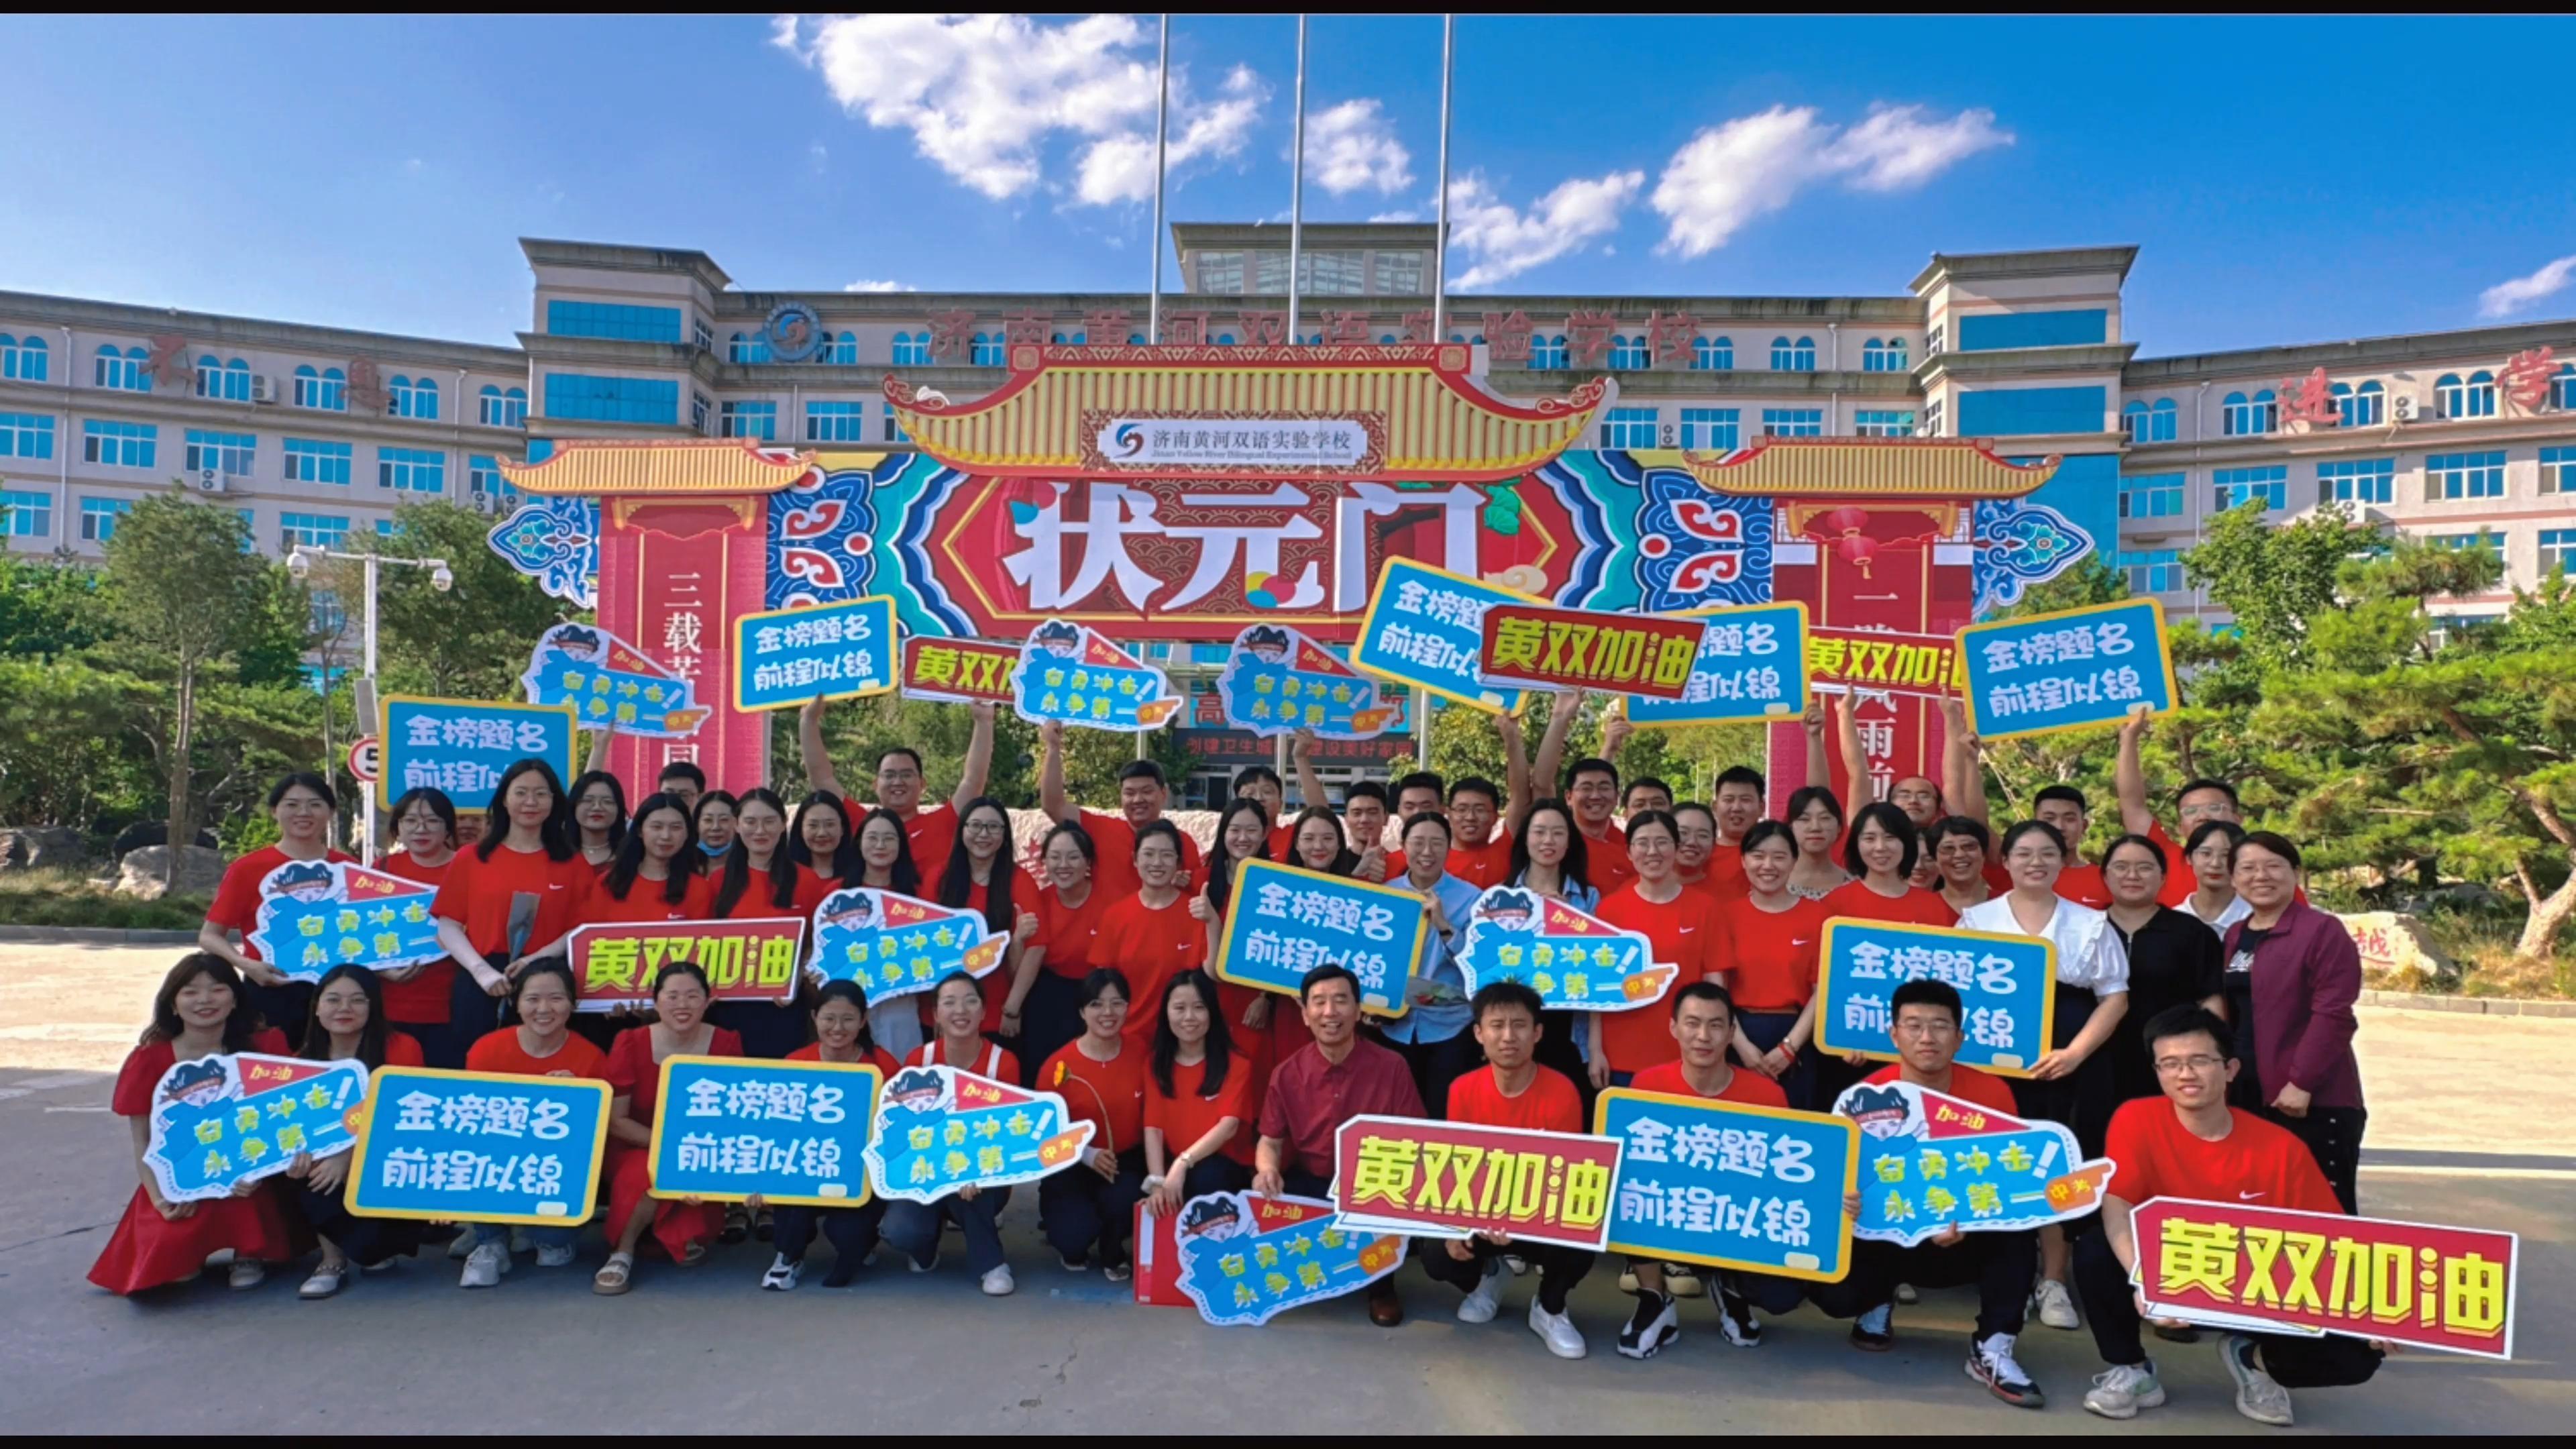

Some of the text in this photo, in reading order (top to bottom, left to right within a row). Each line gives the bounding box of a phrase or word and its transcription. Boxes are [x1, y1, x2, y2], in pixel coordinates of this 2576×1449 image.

[926, 307, 1700, 363] 济南黄河双语实验学校
[1152, 429, 1352, 450] 济南黄河双语实验学校
[1003, 481, 1487, 613] 状元门
[754, 613, 871, 654] 金榜题名
[1378, 622, 1483, 683] 前程似
[1491, 616, 1698, 689] 黄双加油
[1699, 621, 1779, 659] 题名
[1982, 622, 2135, 674] 金榜题名
[753, 649, 873, 692] 前程似锦
[1644, 665, 1781, 705] 程似锦
[1989, 668, 2143, 718] 前程似锦
[405, 714, 549, 753] 金榜题名
[1256, 880, 1394, 942] 金榜题名
[584, 934, 796, 993] 黄双加油
[1245, 928, 1387, 989] 前程似锦
[1849, 941, 2018, 994] 金榜题名
[1501, 971, 1623, 1001] 争第一
[248, 1063, 293, 1081] 加油
[963, 1083, 1002, 1103] 加油
[394, 1090, 570, 1140] 金榜题名
[685, 1077, 847, 1124] 金榜题名
[1935, 1104, 1987, 1131] 加油
[382, 1146, 564, 1197] 前程似锦
[678, 1134, 842, 1179] 前程似锦
[910, 1145, 1038, 1184] 永争第一
[1626, 1116, 1817, 1183] 金榜题名
[1350, 1135, 1610, 1229] 黄双加油
[1884, 1181, 2047, 1223] 永争第一
[2049, 1177, 2092, 1201] 中考
[1261, 1203, 1303, 1220] 加油
[1619, 1177, 1811, 1247] 前程似锦
[1233, 1260, 1360, 1309] 永争第一
[2157, 1216, 2506, 1340] 黄双加油
